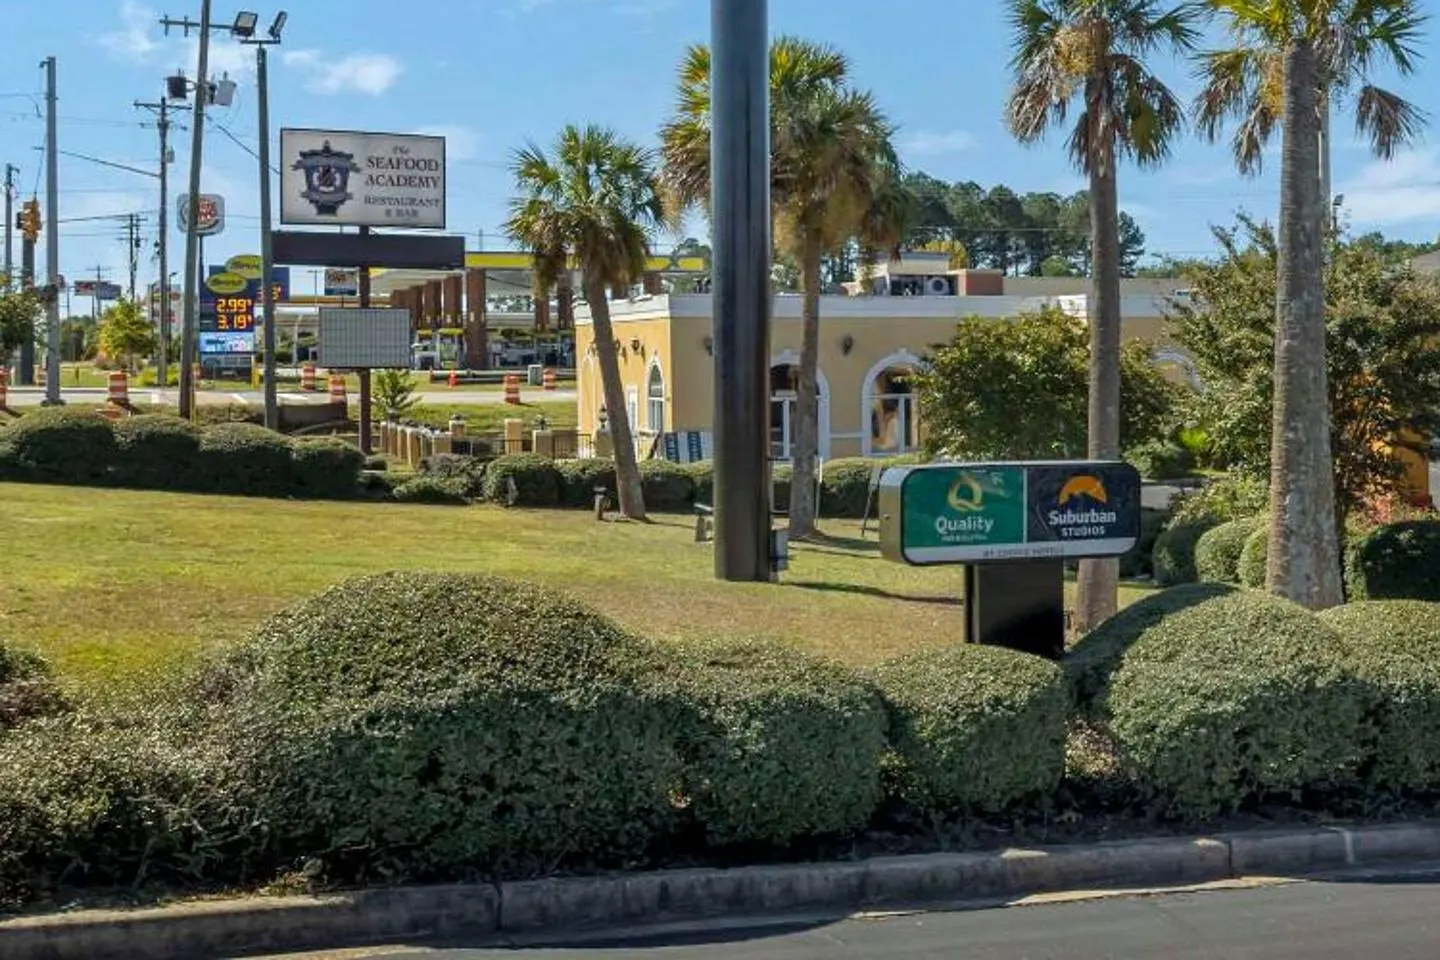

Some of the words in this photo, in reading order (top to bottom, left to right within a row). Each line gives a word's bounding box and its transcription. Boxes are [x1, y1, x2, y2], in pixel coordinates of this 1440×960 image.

[366, 155, 439, 171] SEAFOOD
[364, 174, 441, 188] ACADEMY
[934, 515, 994, 534] Quality
[1048, 509, 1116, 525] Suburban
[1061, 525, 1105, 537] STUDIOS
